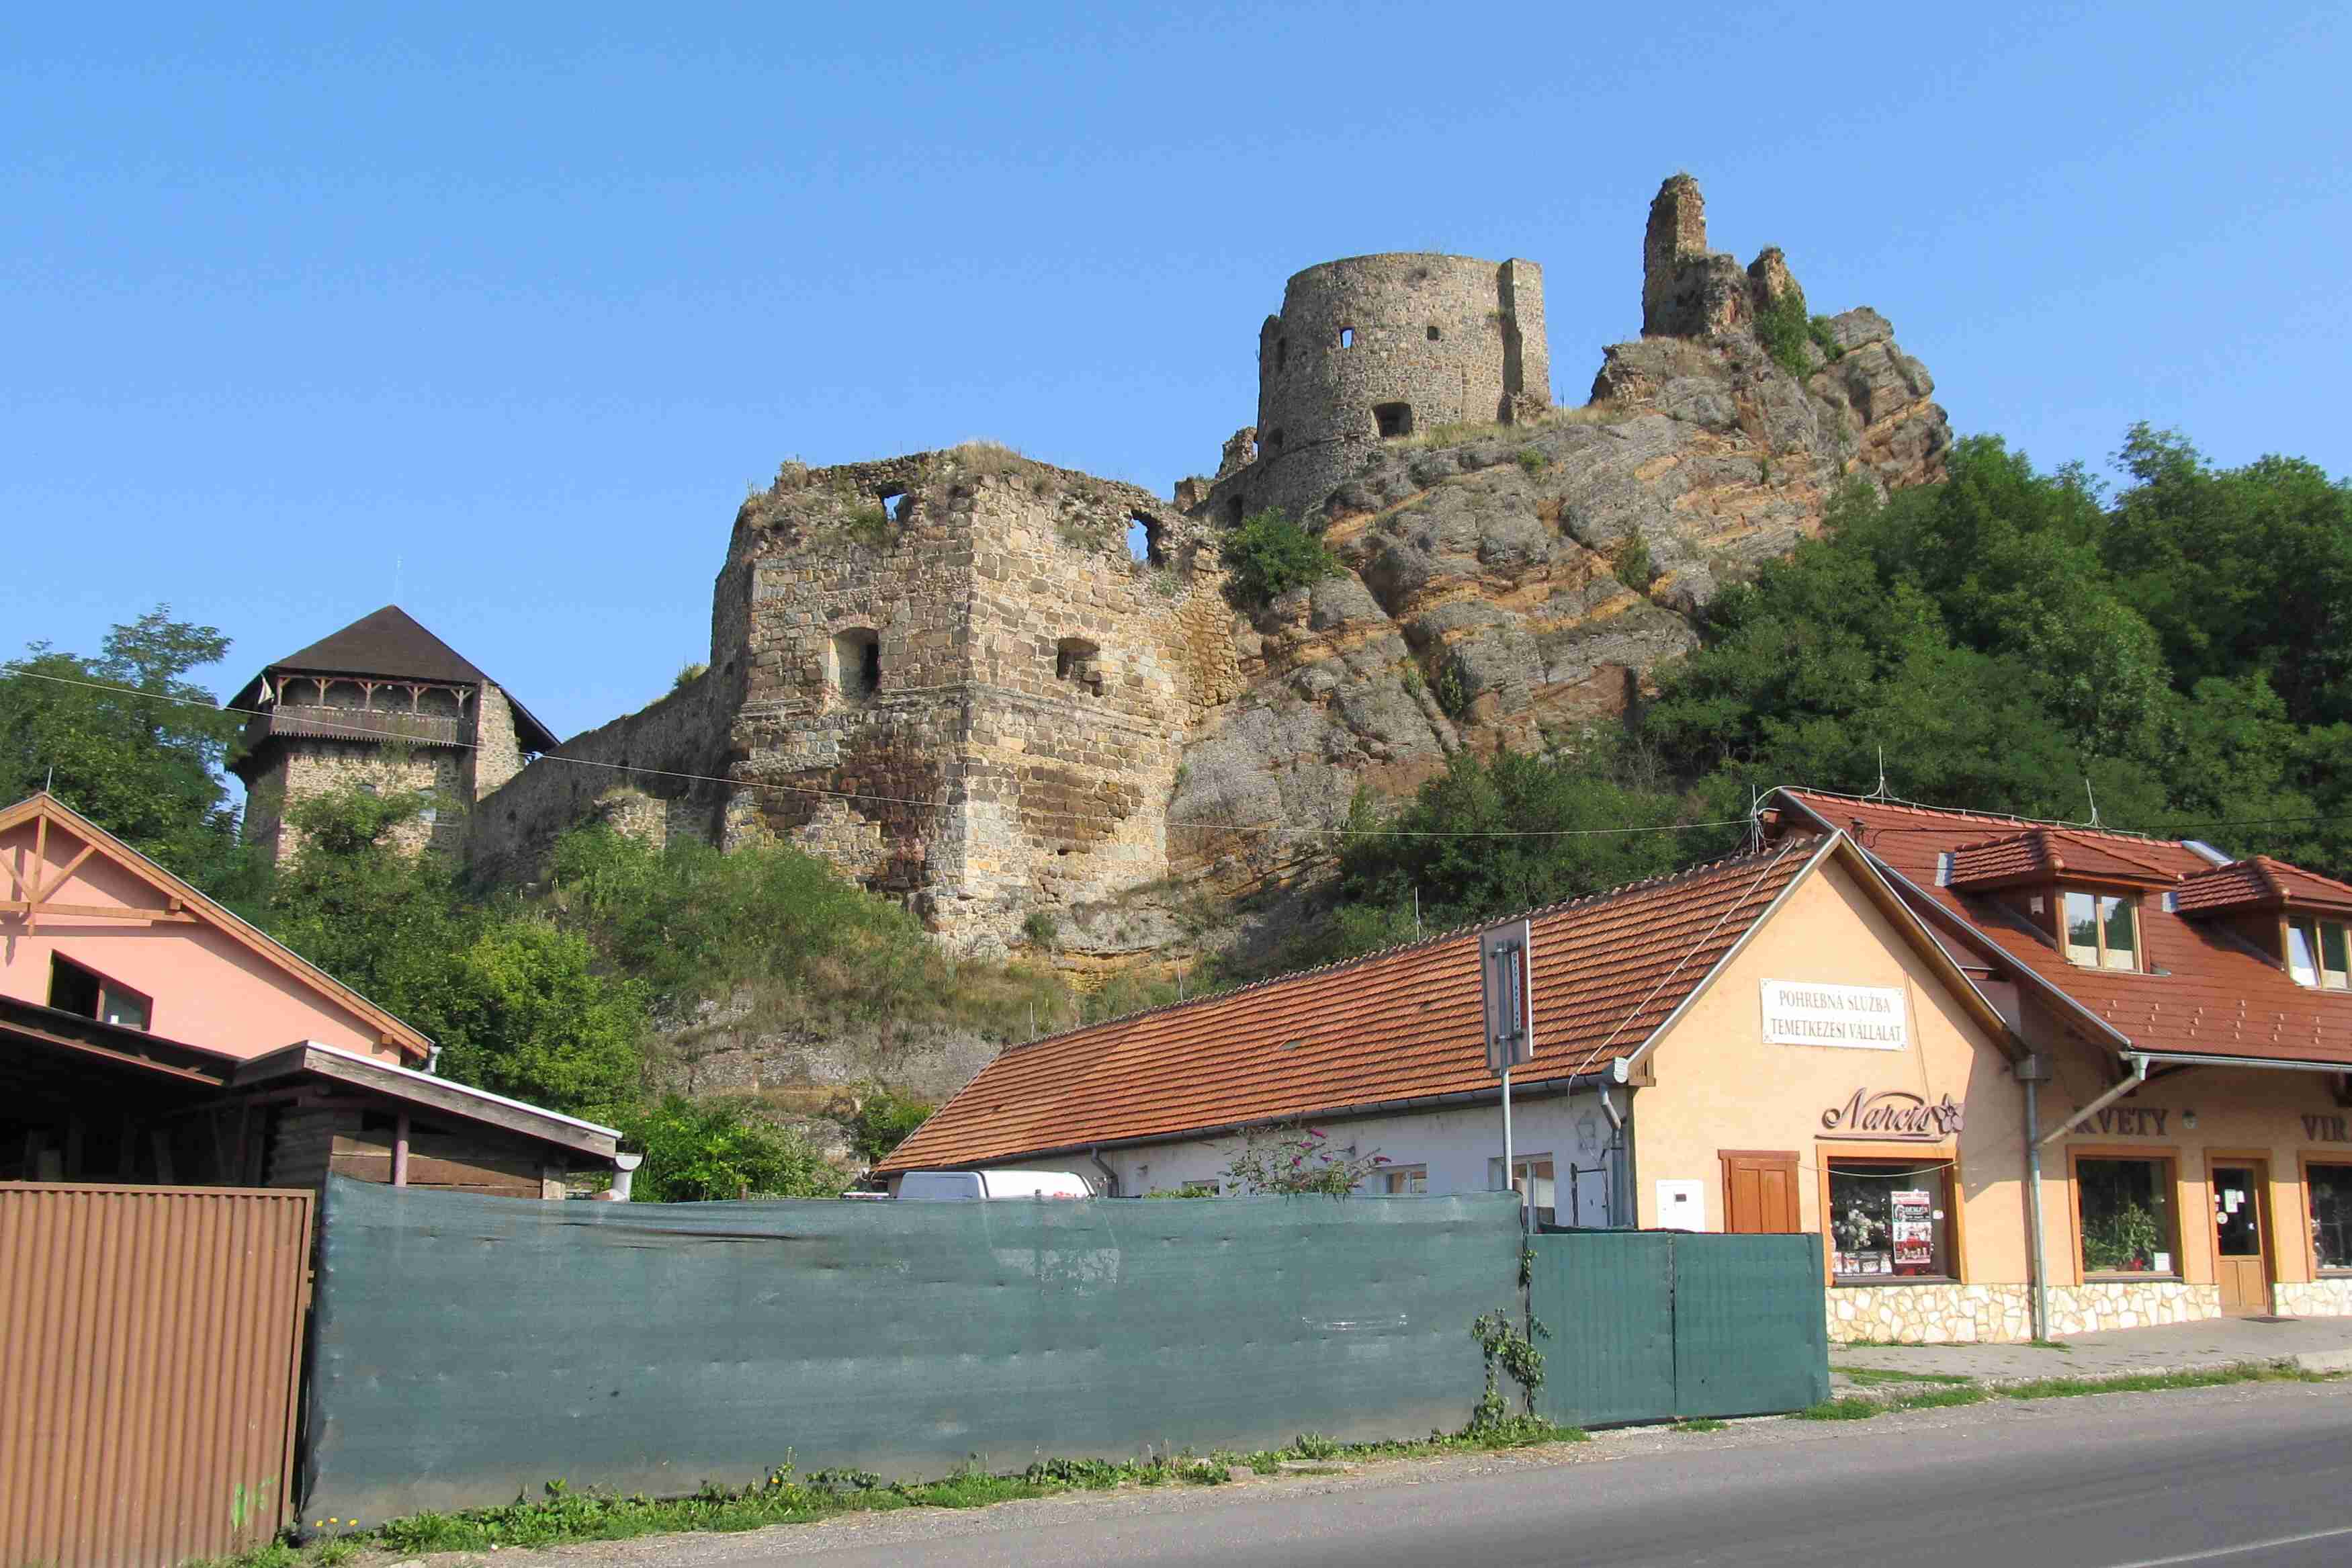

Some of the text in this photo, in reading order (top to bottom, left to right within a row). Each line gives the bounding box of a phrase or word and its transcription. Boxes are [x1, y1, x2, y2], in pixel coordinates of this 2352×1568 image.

[1779, 990, 1891, 1012] POHREBNÁ SLUŽBA
[1771, 1017, 1902, 1041] TEMETKEZÉSI VÁLLALAT
[1821, 1086, 1932, 1132] Narcis
